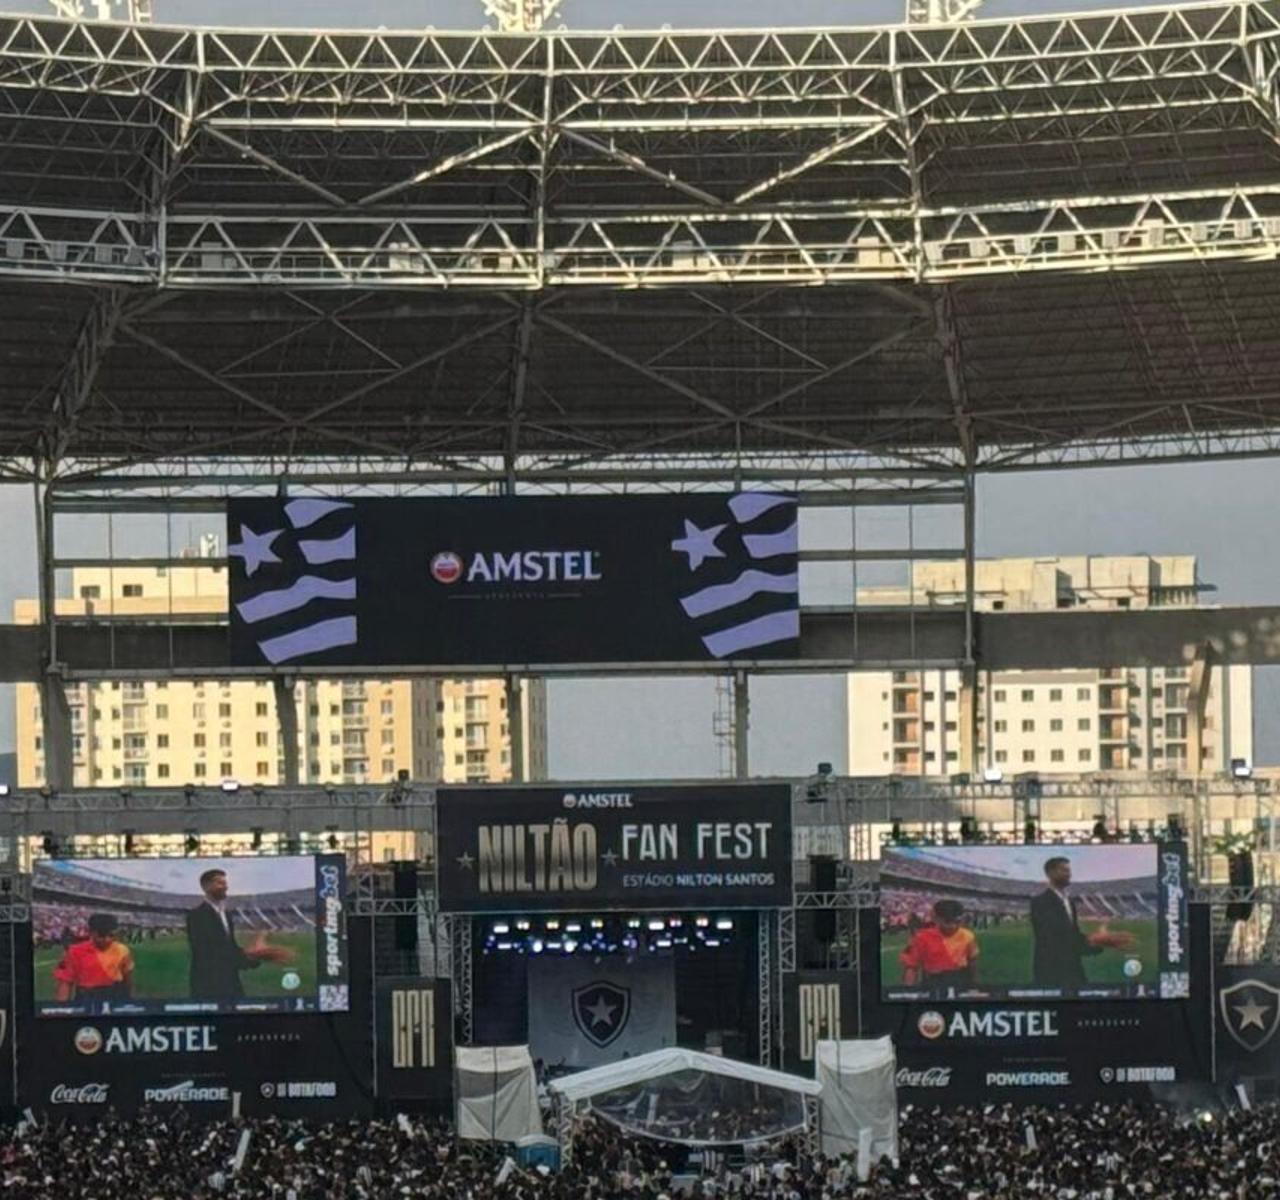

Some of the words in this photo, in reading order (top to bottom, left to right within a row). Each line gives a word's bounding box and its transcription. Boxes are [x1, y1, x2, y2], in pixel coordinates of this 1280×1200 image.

[467, 551, 601, 582] AMSTEL
[577, 794, 633, 808] AMSTEL
[622, 823, 678, 862] FAN
[696, 822, 772, 860] FEST
[478, 817, 598, 893] NILTÃO
[622, 872, 673, 888] ESTÁDIO
[675, 873, 723, 887] NILTON
[725, 872, 775, 886] SANTOS
[947, 1011, 1059, 1036] AMSTEL
[105, 1026, 218, 1053] AMSTEL
[987, 1072, 1072, 1086] POWERADE
[144, 1087, 230, 1102] POWERADE
